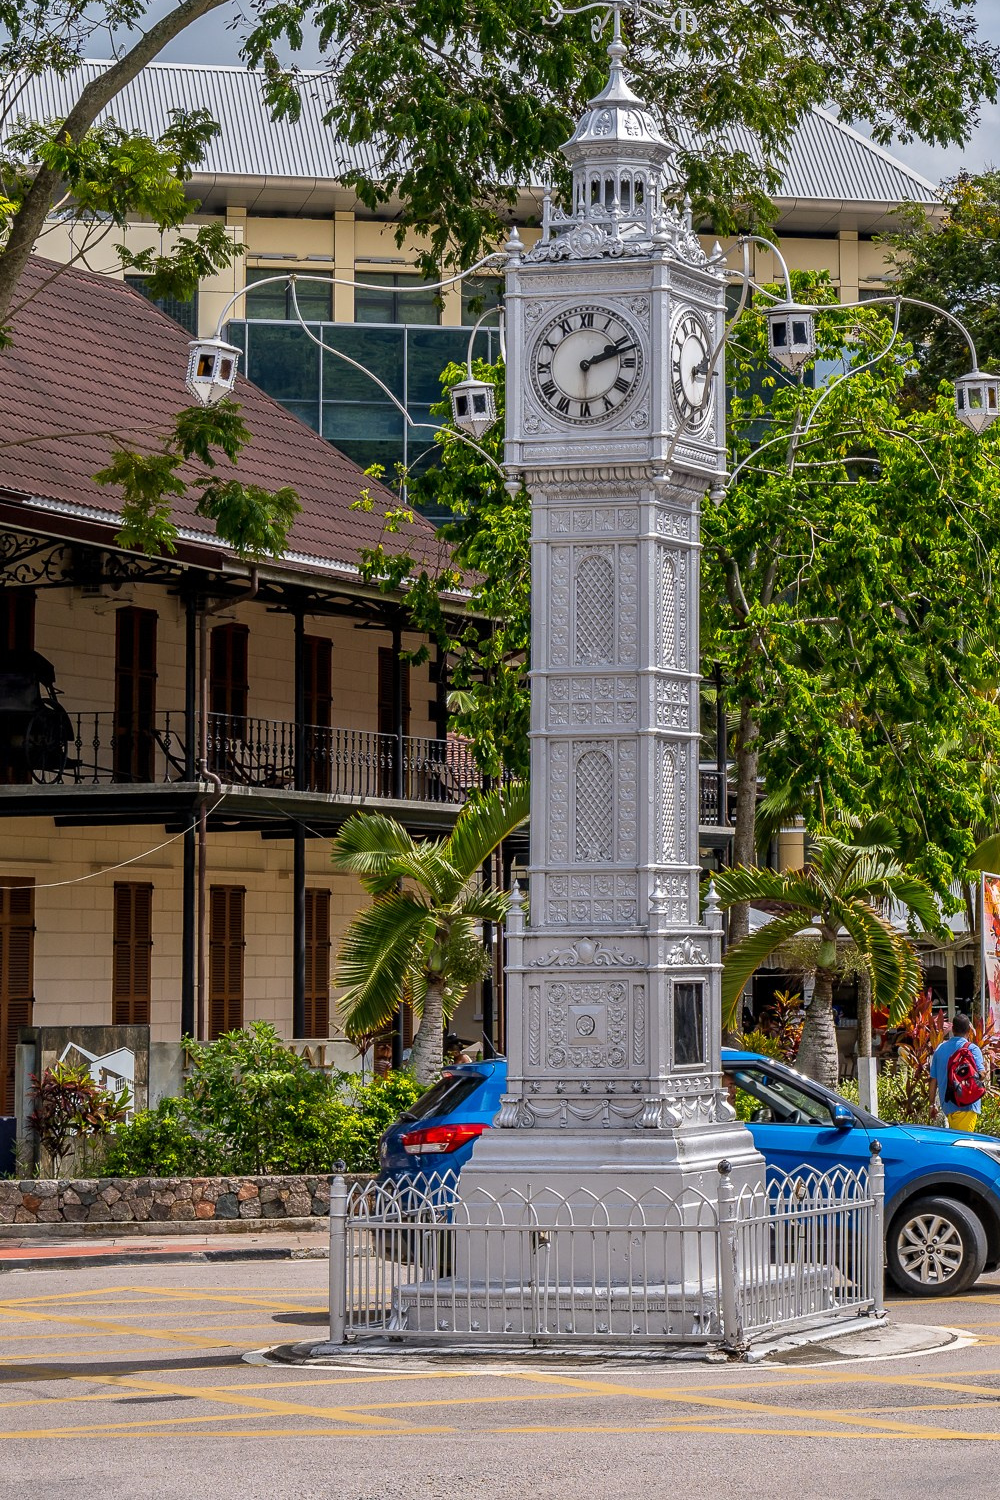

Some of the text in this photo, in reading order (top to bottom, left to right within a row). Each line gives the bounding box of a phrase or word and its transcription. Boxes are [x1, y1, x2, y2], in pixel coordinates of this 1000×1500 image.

[580, 313, 594, 328] XII
[558, 319, 573, 337] XI
[543, 339, 558, 351] X
[537, 362, 551, 374] IX
[620, 358, 635, 368] III
[602, 395, 614, 411] V
